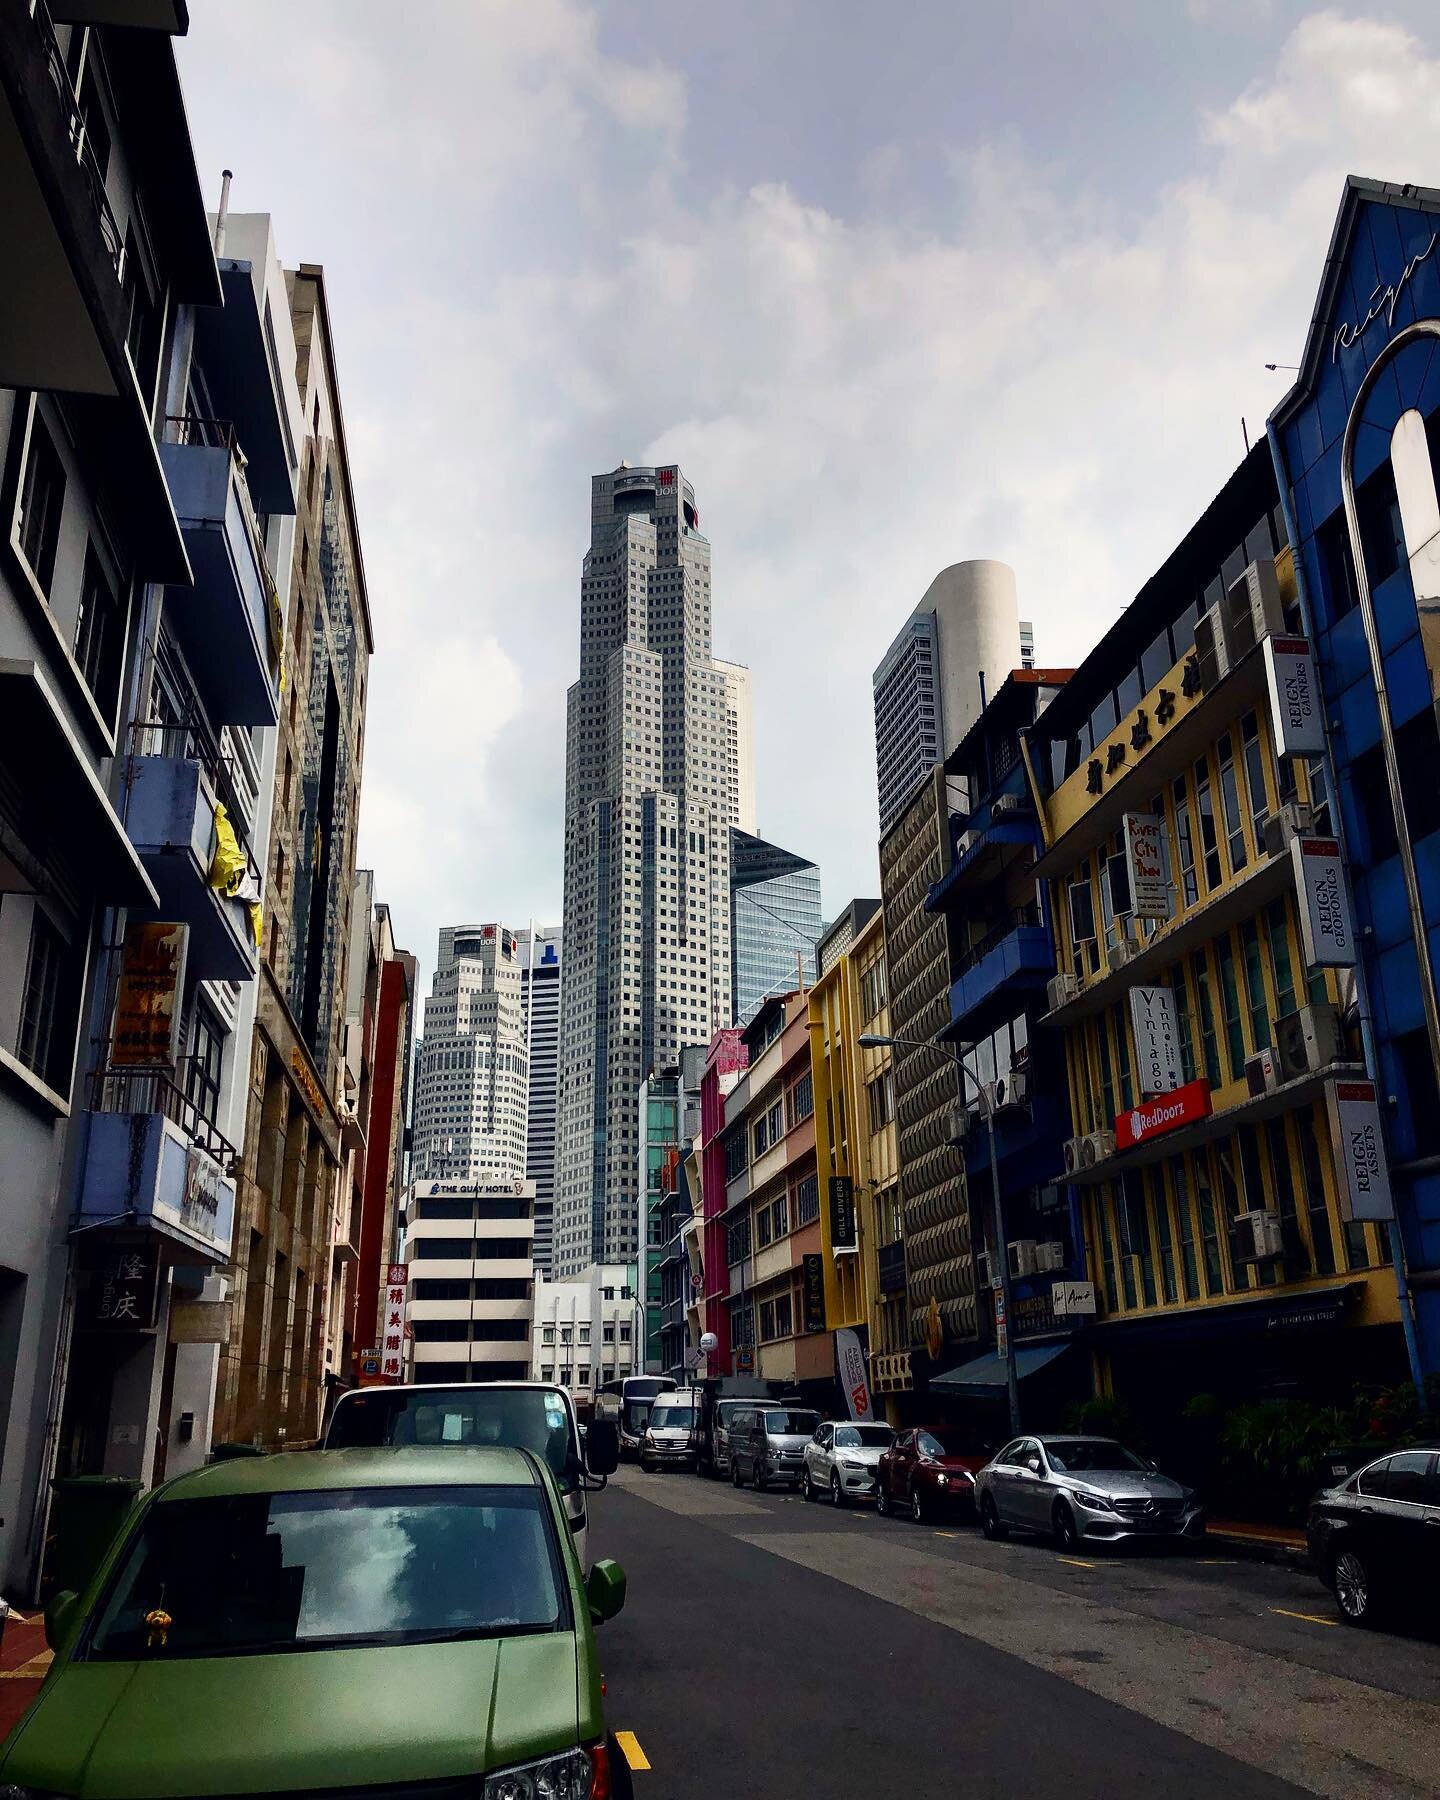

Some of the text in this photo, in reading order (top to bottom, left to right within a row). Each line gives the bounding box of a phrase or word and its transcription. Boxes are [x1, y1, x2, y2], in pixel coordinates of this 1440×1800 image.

[655, 487, 678, 496] UOB
[1285, 678, 1303, 728] REIGN
[1296, 662, 1312, 717] GAINERS
[1314, 880, 1333, 936] REIGN
[1326, 868, 1346, 947] GEOPONICS
[480, 938, 496, 946] UOB
[1140, 1102, 1185, 1131] RedDoorz
[1350, 1131, 1371, 1193] REIGN
[1363, 1125, 1380, 1178] ASSETS
[440, 1185, 513, 1193] THE QUAY HOTEL
[836, 1179, 846, 1238] GILL DIVERS
